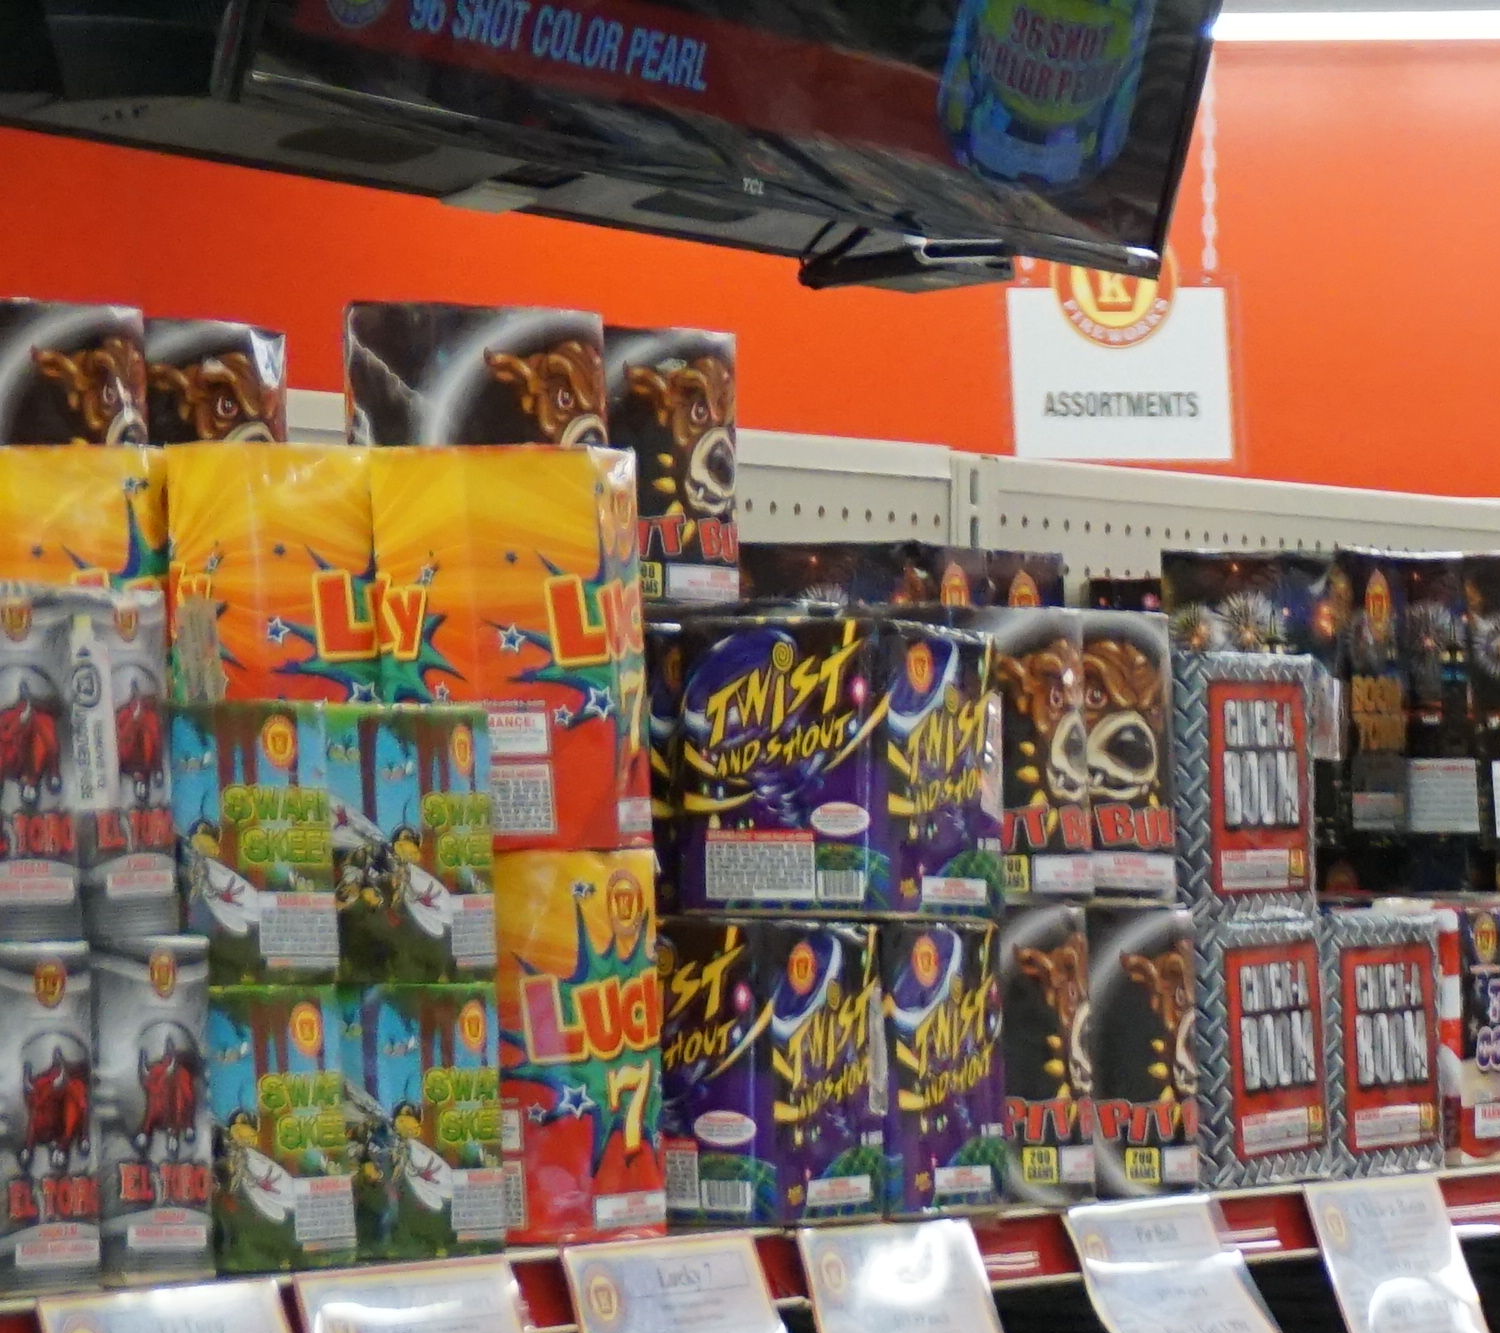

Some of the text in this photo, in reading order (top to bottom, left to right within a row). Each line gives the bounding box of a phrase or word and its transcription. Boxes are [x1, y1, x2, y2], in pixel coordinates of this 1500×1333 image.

[453, 0, 530, 50] SHOT
[533, 4, 618, 71] COLOR
[626, 28, 707, 91] PEARL
[1044, 391, 1200, 417] ASSORTMENTS
[706, 636, 865, 747] TWIST
[714, 713, 850, 779] AND SHOUT
[607, 1058, 654, 1157] 7
[1005, 1100, 1069, 1143] PIT
[1101, 1101, 1175, 1143] PIT
[120, 1161, 153, 1201] EL
